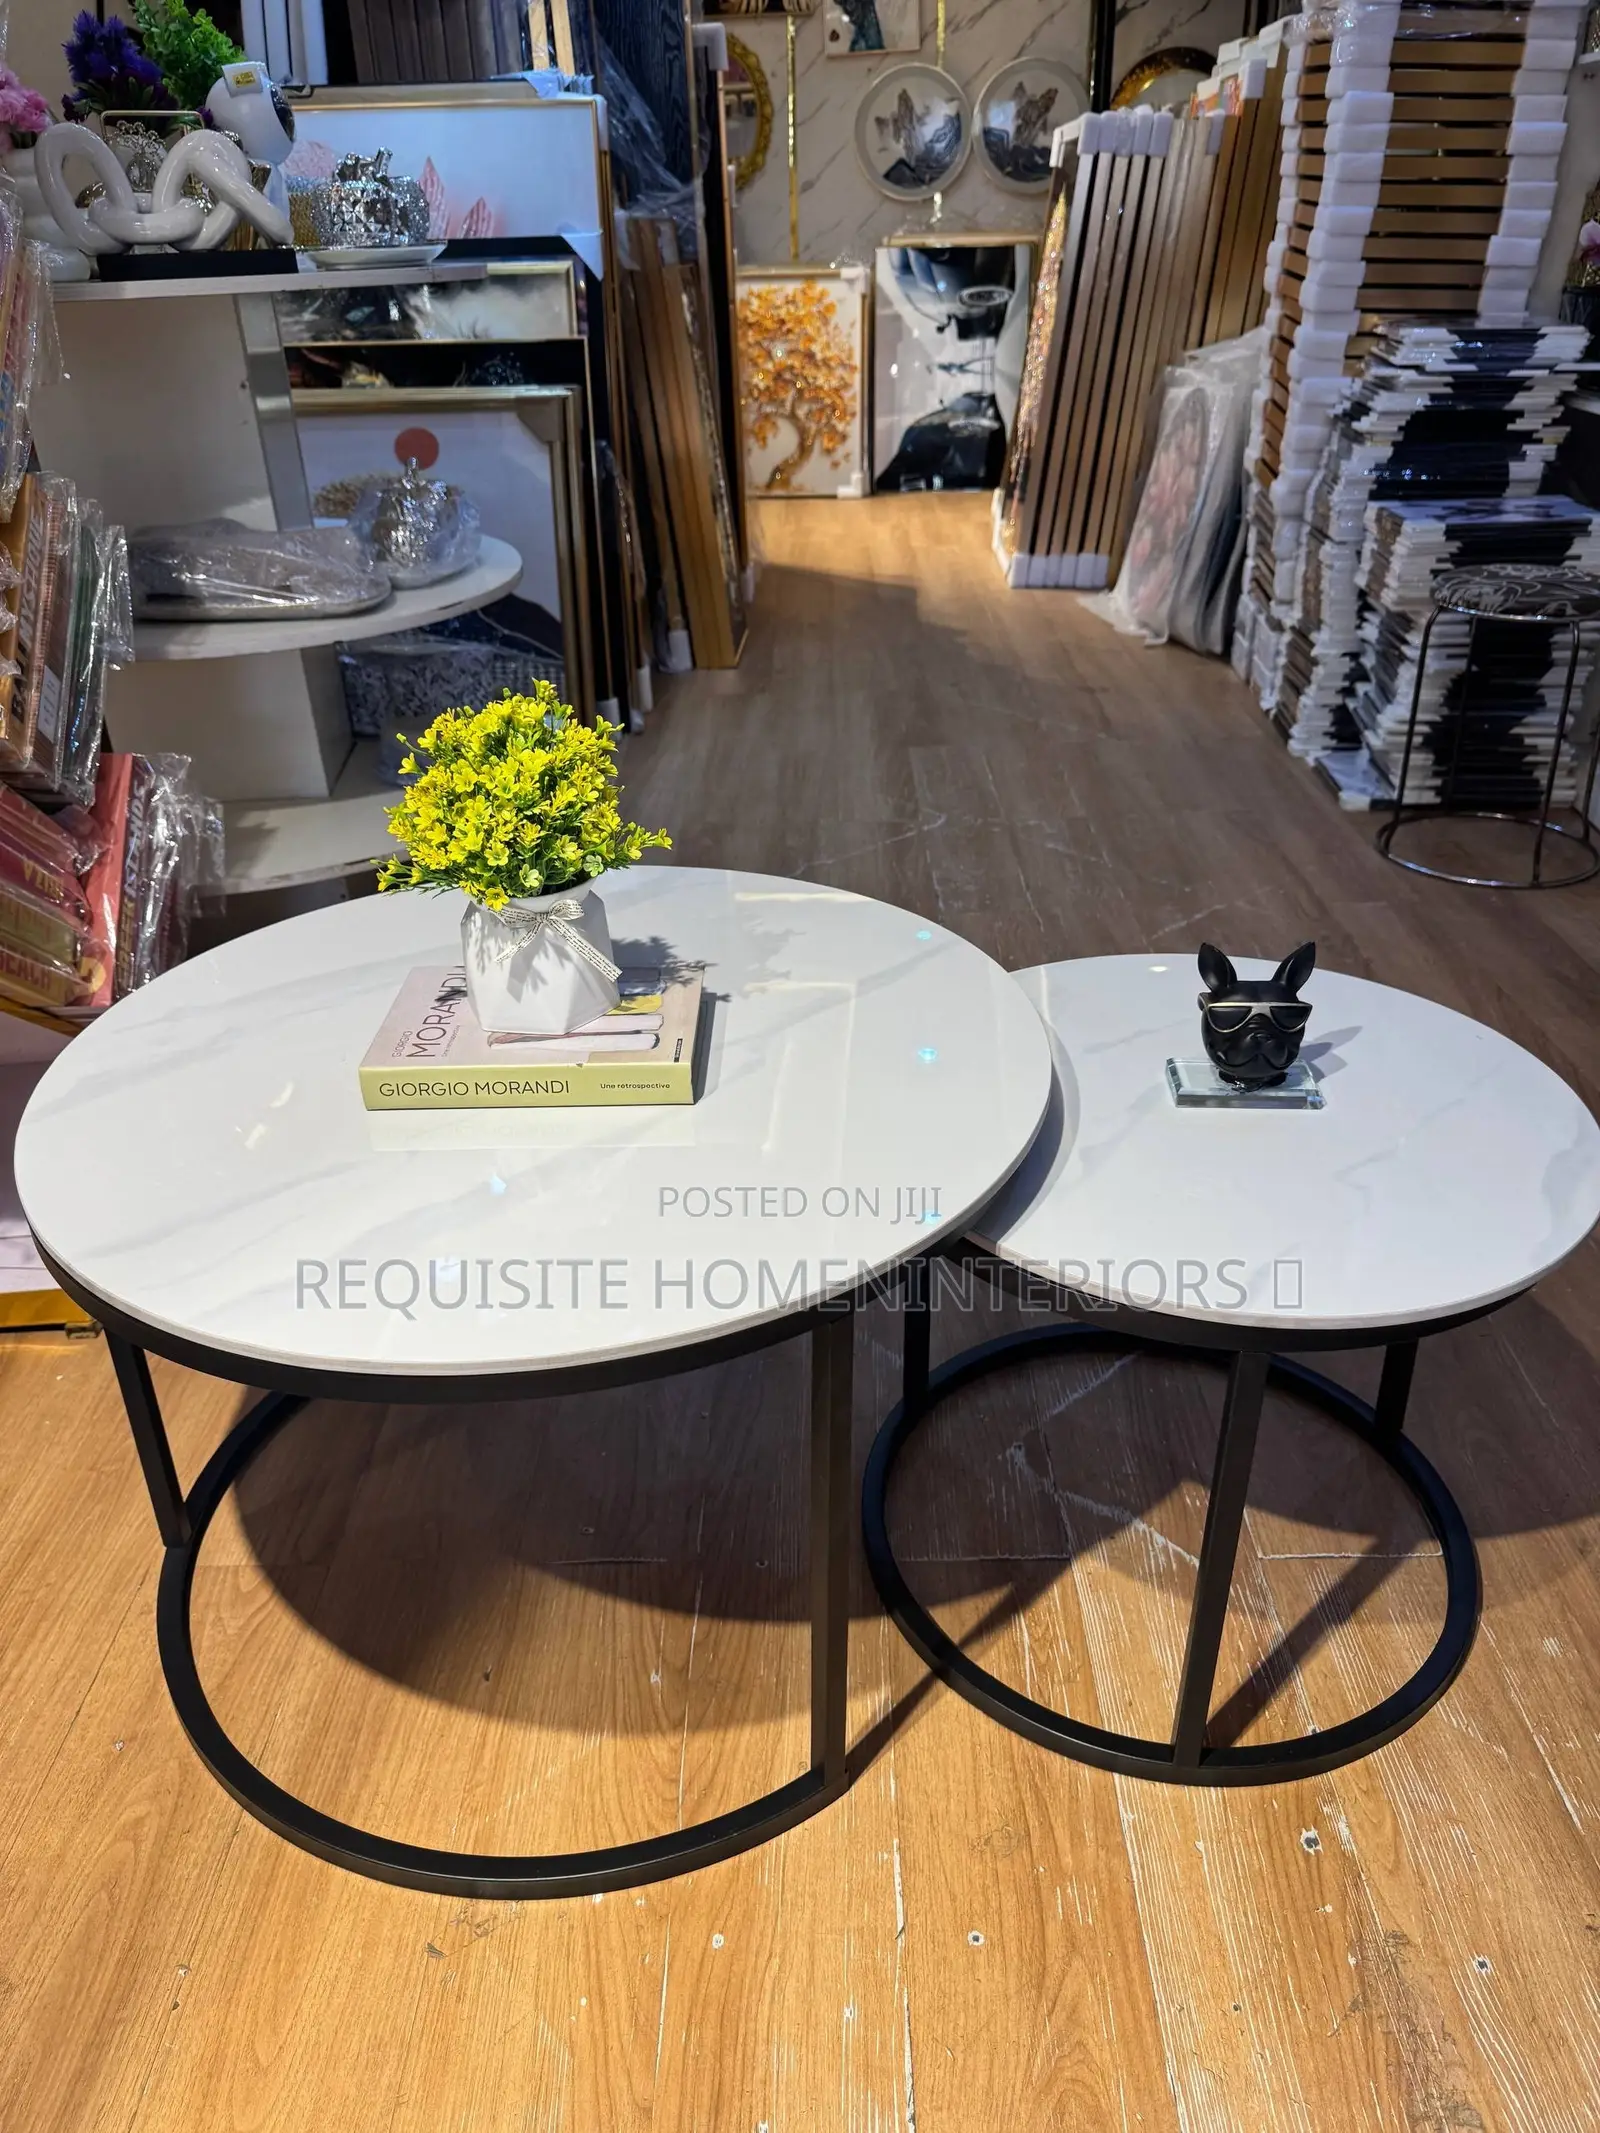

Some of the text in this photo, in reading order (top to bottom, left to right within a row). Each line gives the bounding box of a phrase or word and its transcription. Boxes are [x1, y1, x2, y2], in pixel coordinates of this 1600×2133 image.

[405, 973, 467, 1058] MORANDI
[379, 1080, 570, 1097] GIORGIO MORANDI
